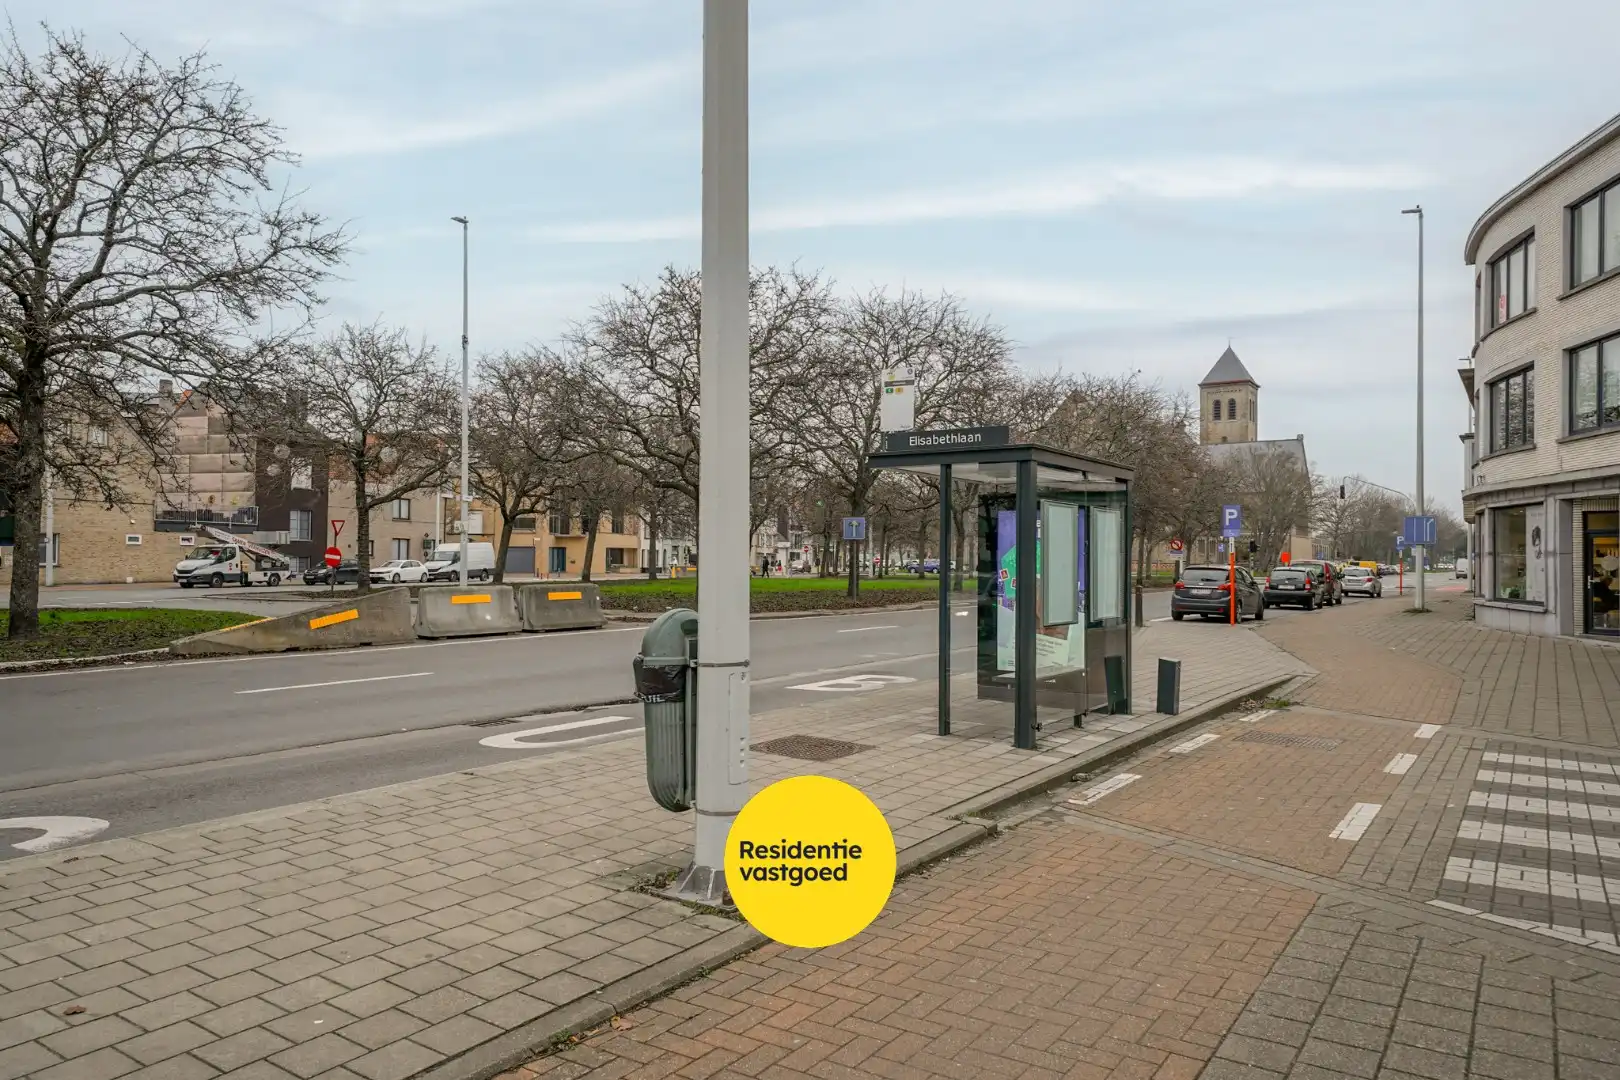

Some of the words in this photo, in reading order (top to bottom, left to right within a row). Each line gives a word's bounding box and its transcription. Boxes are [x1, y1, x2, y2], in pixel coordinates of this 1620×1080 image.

[909, 432, 982, 447] Elisabethlaan
[1225, 508, 1238, 526] P
[1396, 535, 1405, 545] P
